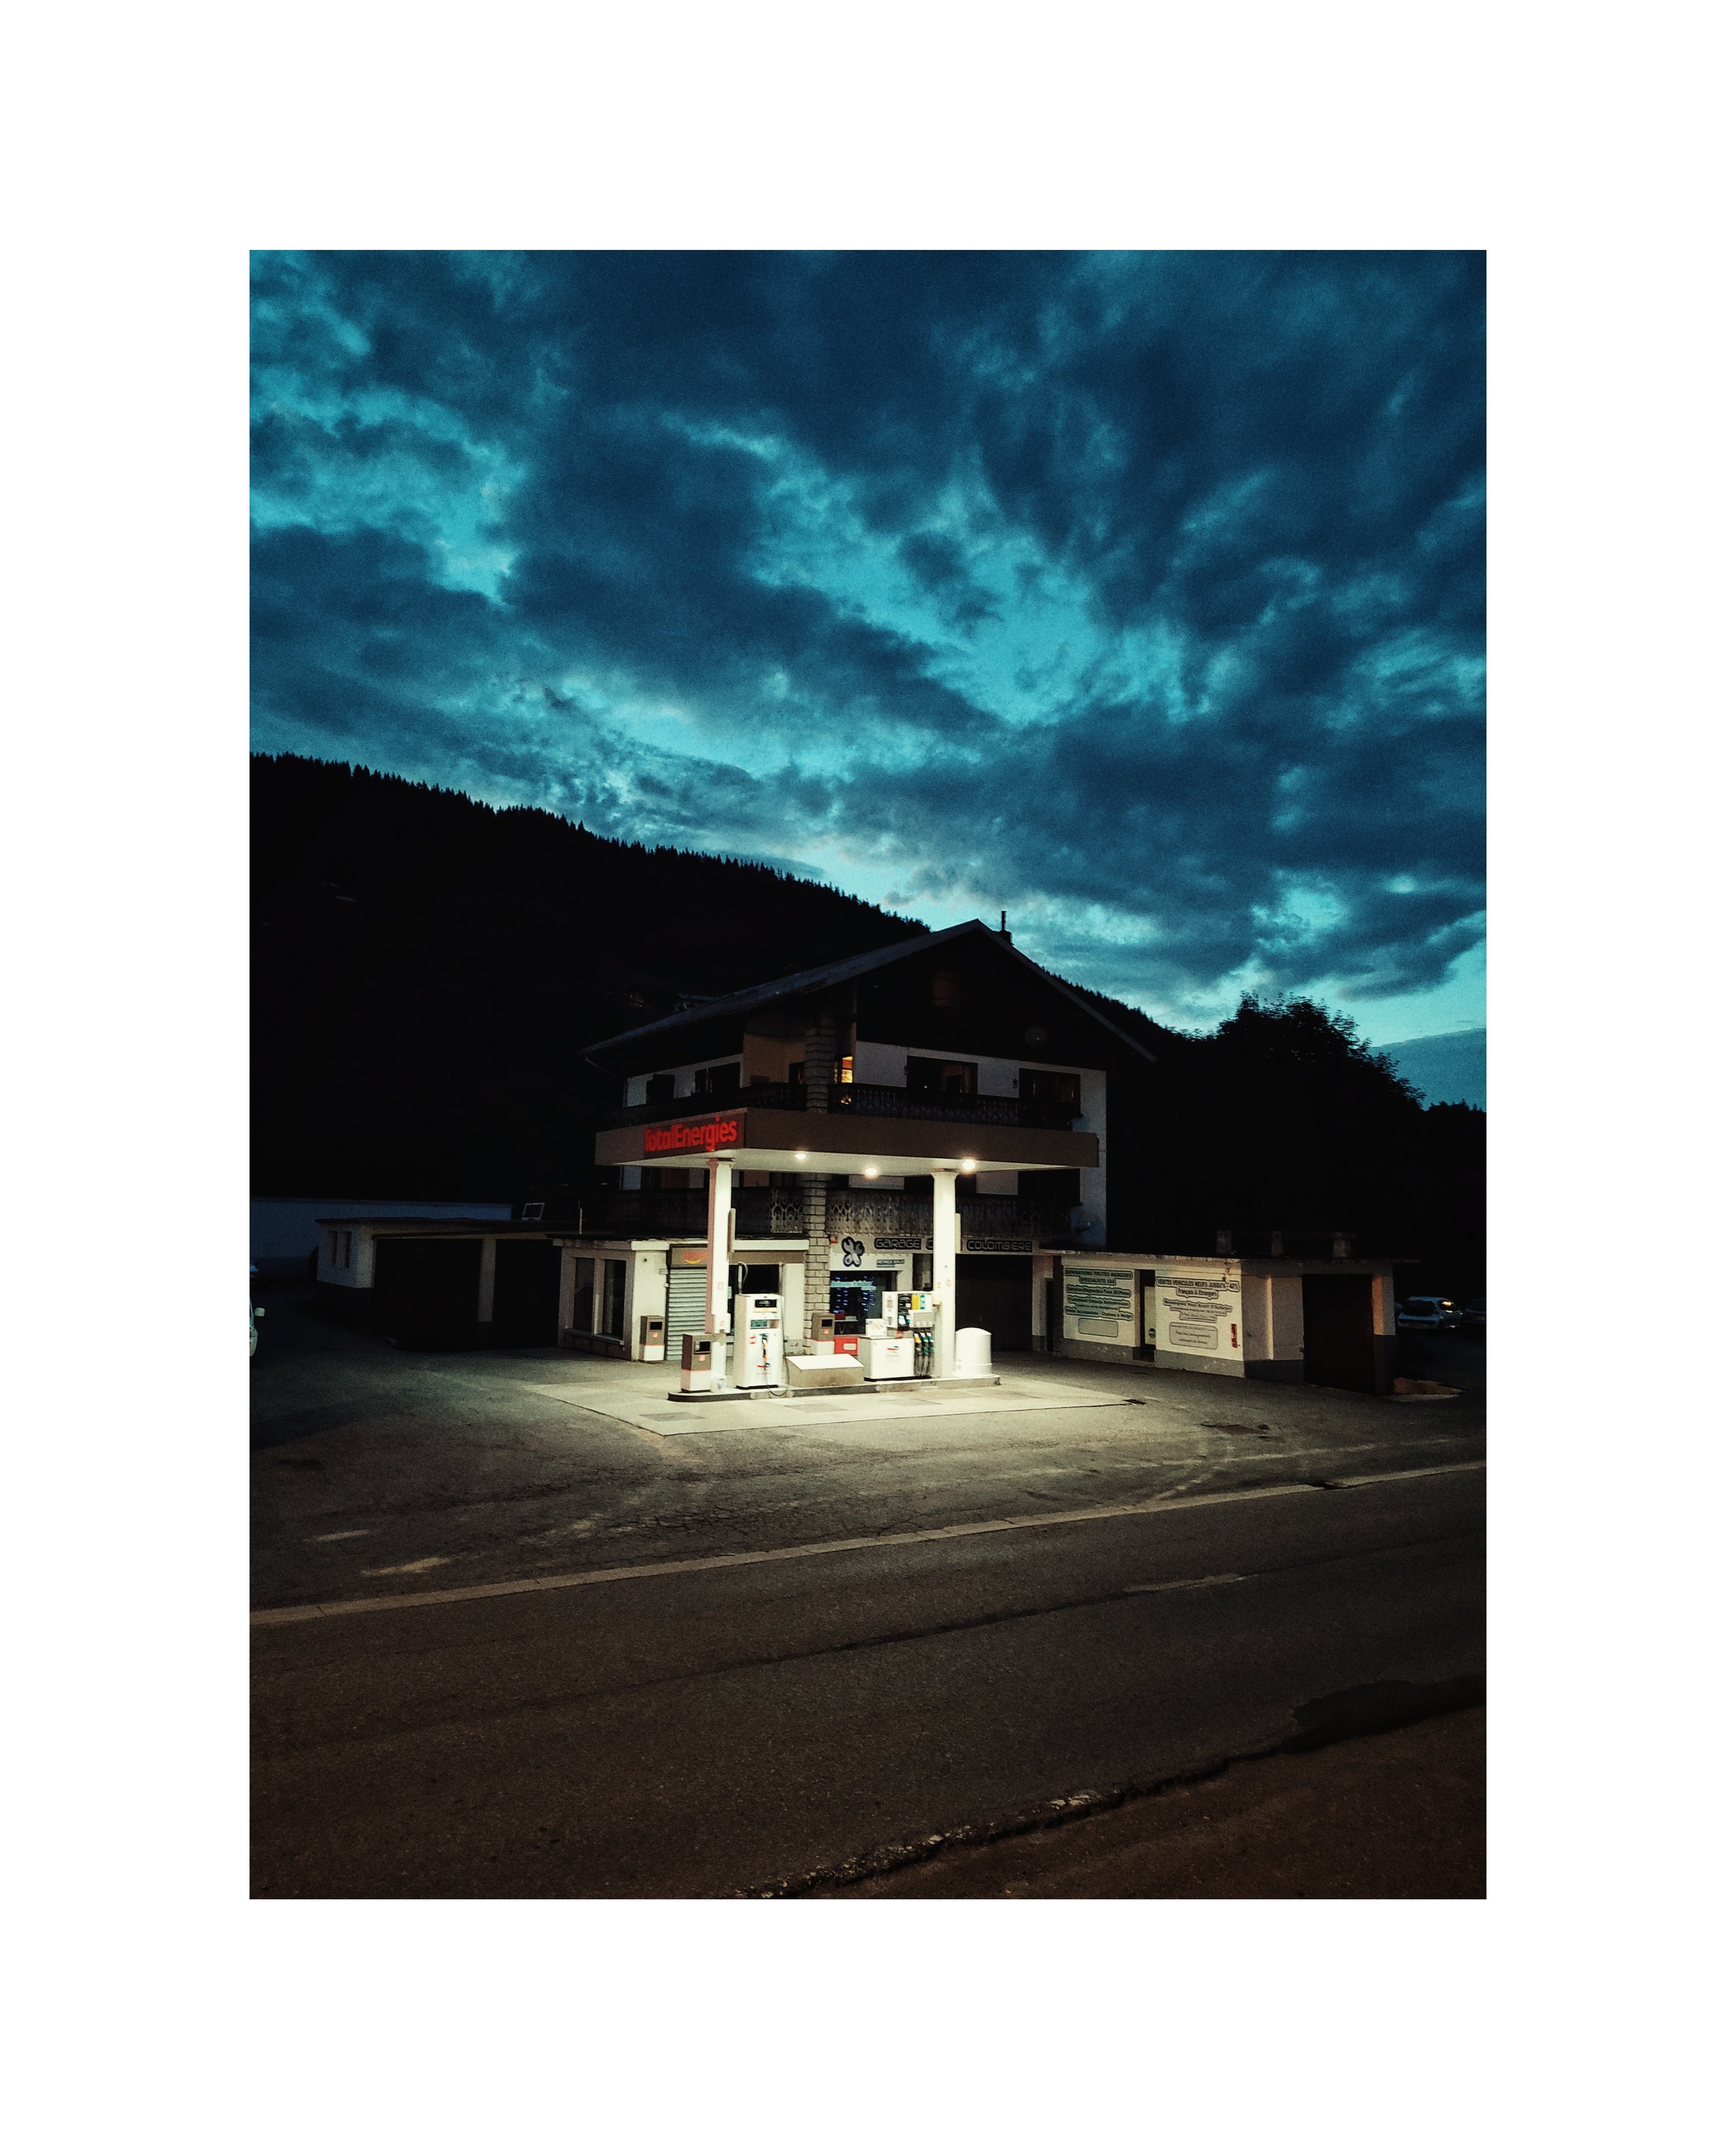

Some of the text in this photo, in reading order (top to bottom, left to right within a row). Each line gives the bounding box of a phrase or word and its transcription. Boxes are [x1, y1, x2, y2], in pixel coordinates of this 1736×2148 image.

[644, 1116, 737, 1152] TotalEnergies
[876, 1239, 920, 1248] GARAGE
[967, 1240, 1032, 1250] COLOMBIERE
